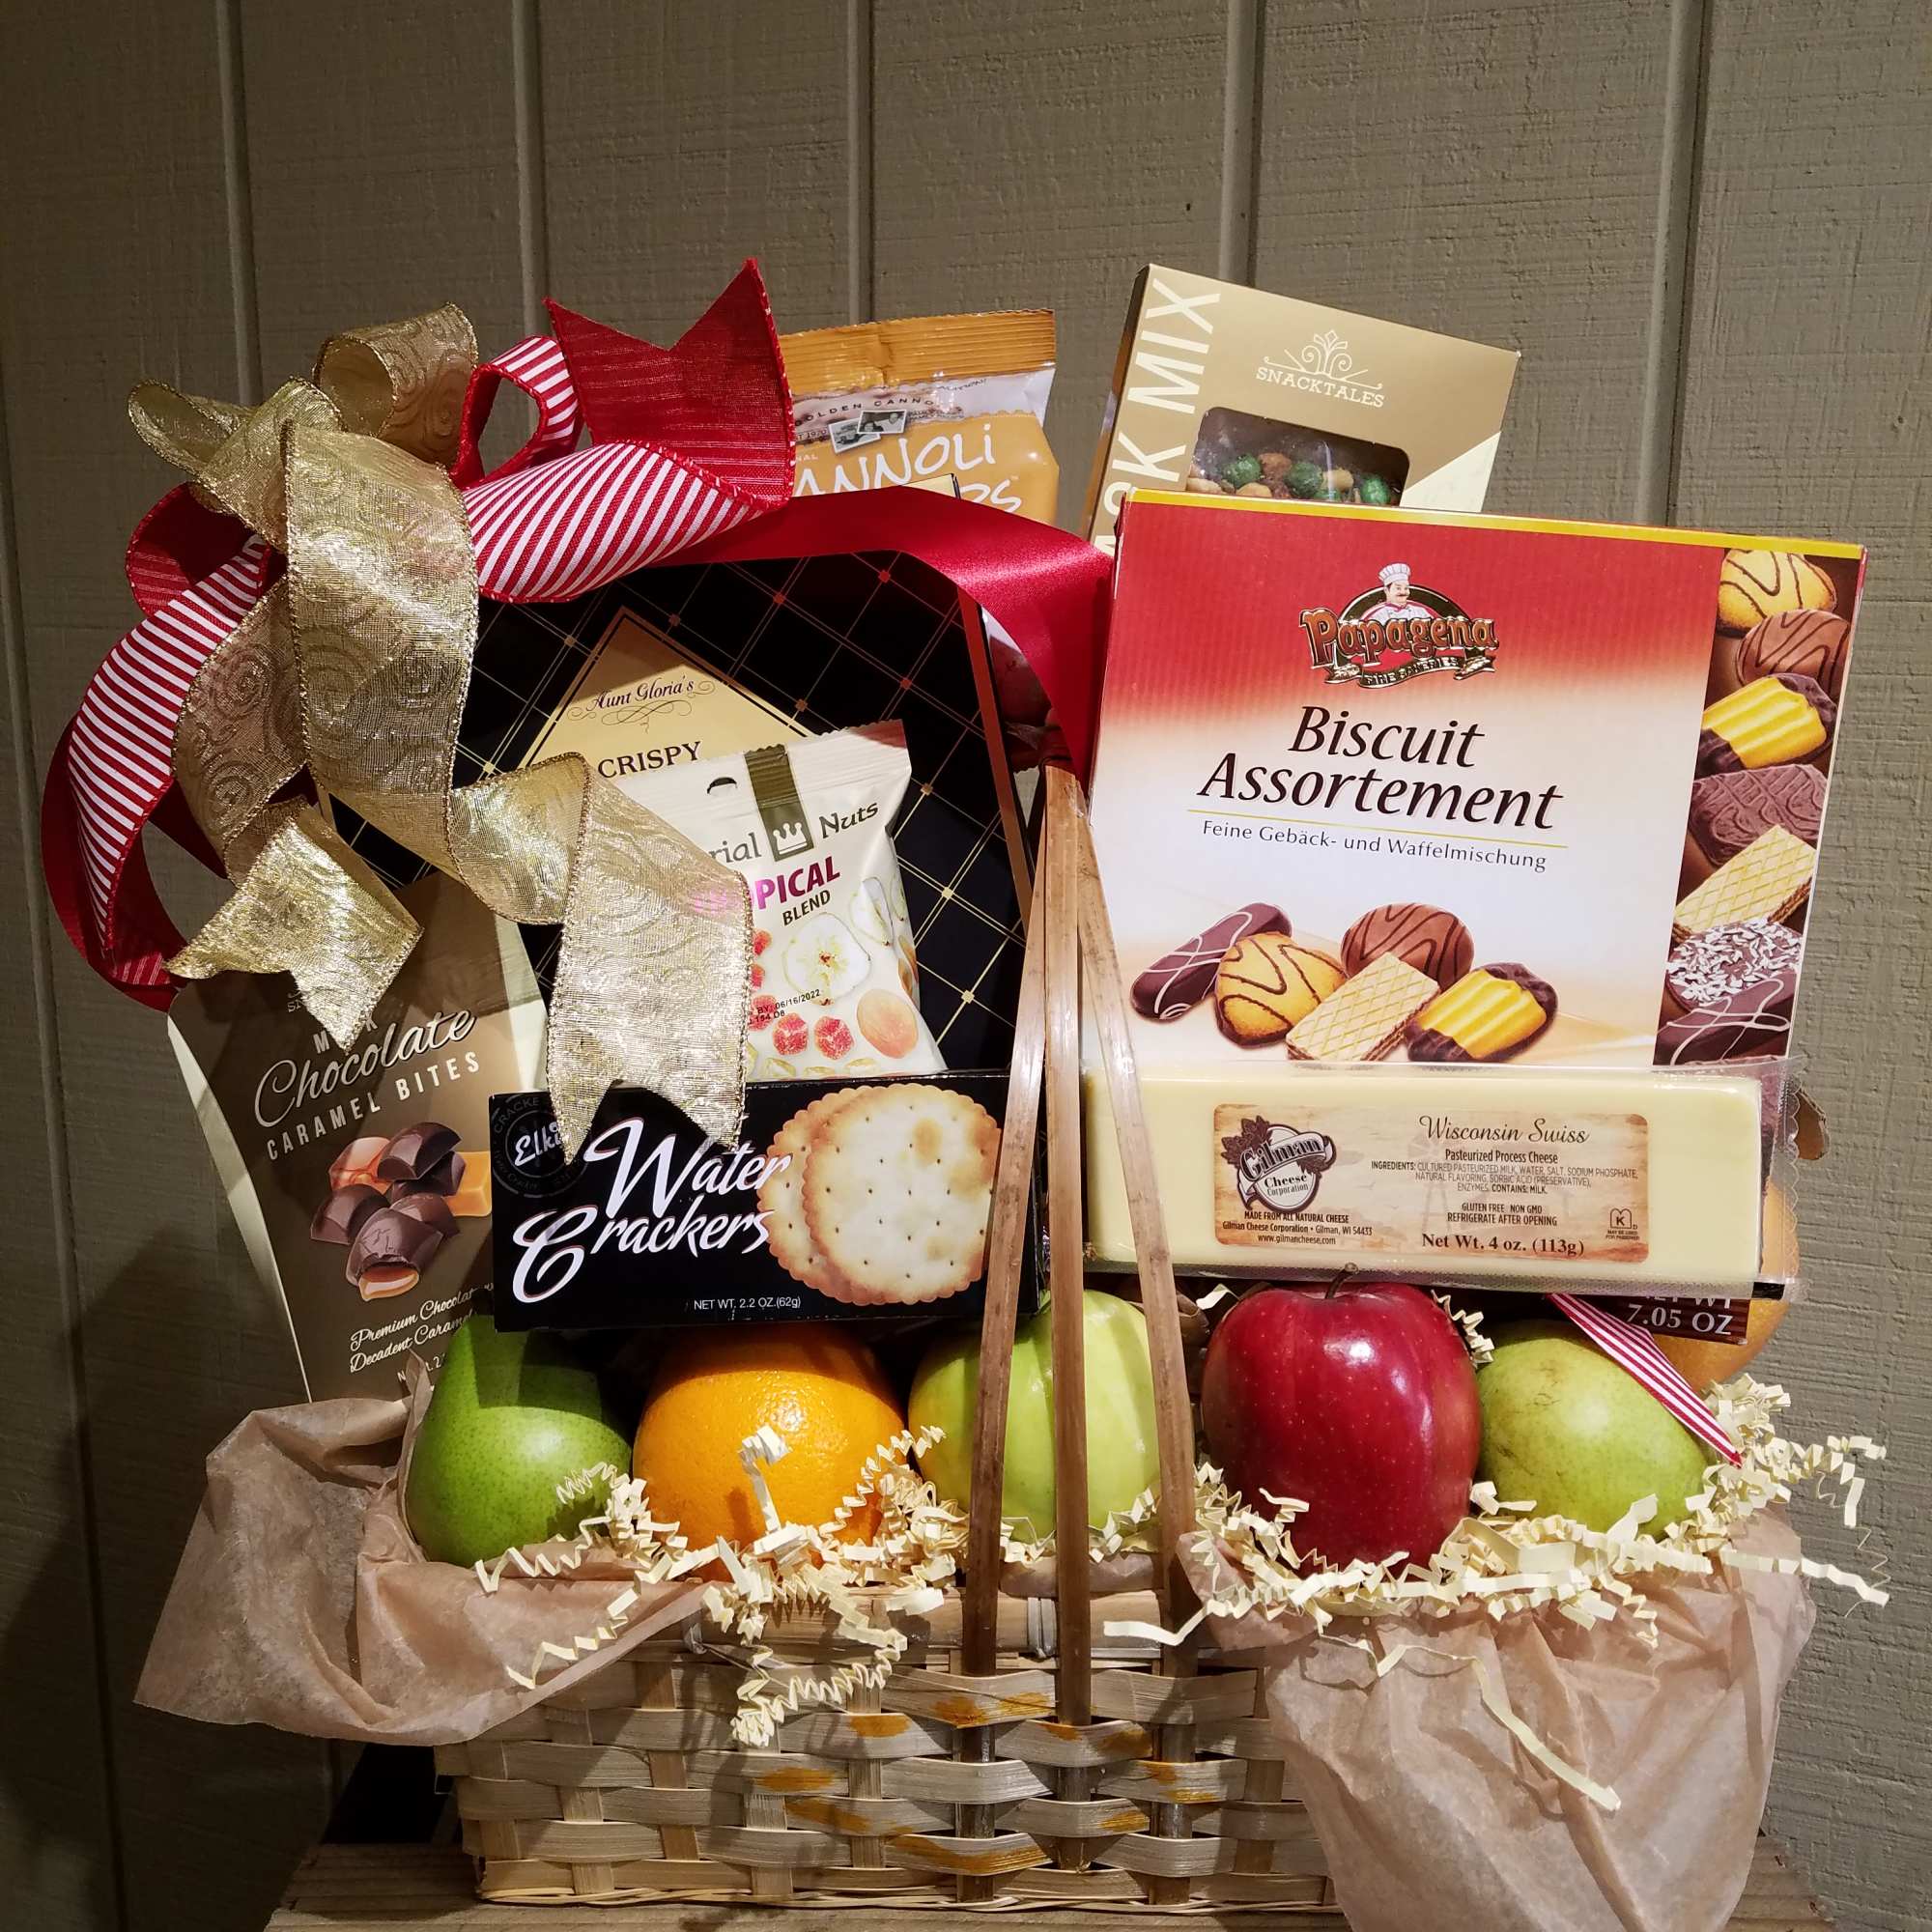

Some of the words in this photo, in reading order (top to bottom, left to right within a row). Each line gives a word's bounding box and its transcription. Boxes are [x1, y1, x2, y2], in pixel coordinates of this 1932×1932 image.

[1127, 278, 1221, 415] MIX
[873, 396, 934, 408] CANNO
[1256, 367, 1386, 408] SNACKTALES
[1298, 608, 1499, 669] Papagena
[583, 687, 631, 710] Aunt
[637, 674, 695, 701] Gloria's
[1288, 705, 1486, 768] Biscuit
[597, 741, 701, 779] CRISPY
[1196, 753, 1564, 830] Assortement
[818, 802, 879, 838] Nuts
[1203, 820, 1253, 840] Feine
[1260, 826, 1336, 847] Gebäck-
[1345, 835, 1380, 852] und
[1389, 838, 1547, 873] Waffelmischung
[754, 856, 840, 910] PICAL
[782, 890, 831, 926] BLEND
[775, 988, 820, 1009] 06/16/2022
[313, 1013, 378, 1054] MK
[254, 1009, 478, 1128] Chocolate
[267, 1093, 381, 1161] CARAMEL
[395, 1051, 480, 1100] BITES
[494, 1095, 541, 1133] CRACKE
[514, 1122, 564, 1167] Elki
[1419, 1115, 1522, 1141] Wisconsin
[1528, 1118, 1591, 1144] Swiss
[583, 1118, 793, 1219] Water
[1240, 1140, 1322, 1180] Gilman
[1371, 1160, 1416, 1171] INGREDIENTS:
[1417, 1162, 1453, 1172] CULTURED
[1453, 1163, 1498, 1174] PASTEURIZED
[1567, 1168, 1596, 1177] SODIUM
[1445, 1149, 1493, 1162] Pasteurized
[1495, 1151, 1526, 1163] Process
[1528, 1151, 1558, 1164] Cheese
[1264, 1173, 1307, 1188] Cheese
[1415, 1172, 1446, 1181] NATURAL
[1516, 1176, 1532, 1184] ACID
[1244, 1211, 1262, 1220] MADE
[1264, 1211, 1282, 1221] FROM
[1283, 1212, 1293, 1221] ALL
[1295, 1213, 1324, 1223] NATURAL
[1325, 1214, 1350, 1224] CHEESE
[1447, 1212, 1495, 1224] REFRIGERATE
[1498, 1214, 1521, 1225] AFTER
[1523, 1215, 1558, 1226] OPENING
[1462, 1203, 1487, 1212] GLUTEN
[1488, 1204, 1505, 1213] FREE
[1510, 1205, 1525, 1213] NON
[1526, 1206, 1543, 1214] GMO
[1222, 1221, 1244, 1231] Gilman
[1246, 1222, 1268, 1232] Cheese
[1270, 1224, 1308, 1235] Corporation
[1316, 1226, 1341, 1236] Gilman,
[1342, 1227, 1350, 1236] WI
[1352, 1227, 1373, 1236] 54433
[1257, 1235, 1336, 1246] www.gilmancheese.com
[1421, 1233, 1449, 1247] Net
[1456, 1235, 1485, 1249] Wt.
[1489, 1236, 1498, 1248] 4
[1503, 1238, 1527, 1251] oz.
[1532, 1238, 1585, 1258] (113g)
[512, 1194, 776, 1303] Crackers
[351, 1314, 418, 1351] Premium
[420, 1288, 477, 1321] Chocolat
[694, 1299, 714, 1311] NET
[718, 1299, 736, 1310] WT.
[739, 1298, 756, 1310] 2.2
[1628, 1303, 1682, 1328] 7.05
[1691, 1312, 1734, 1335] OZ
[351, 1336, 412, 1373] Decadent
